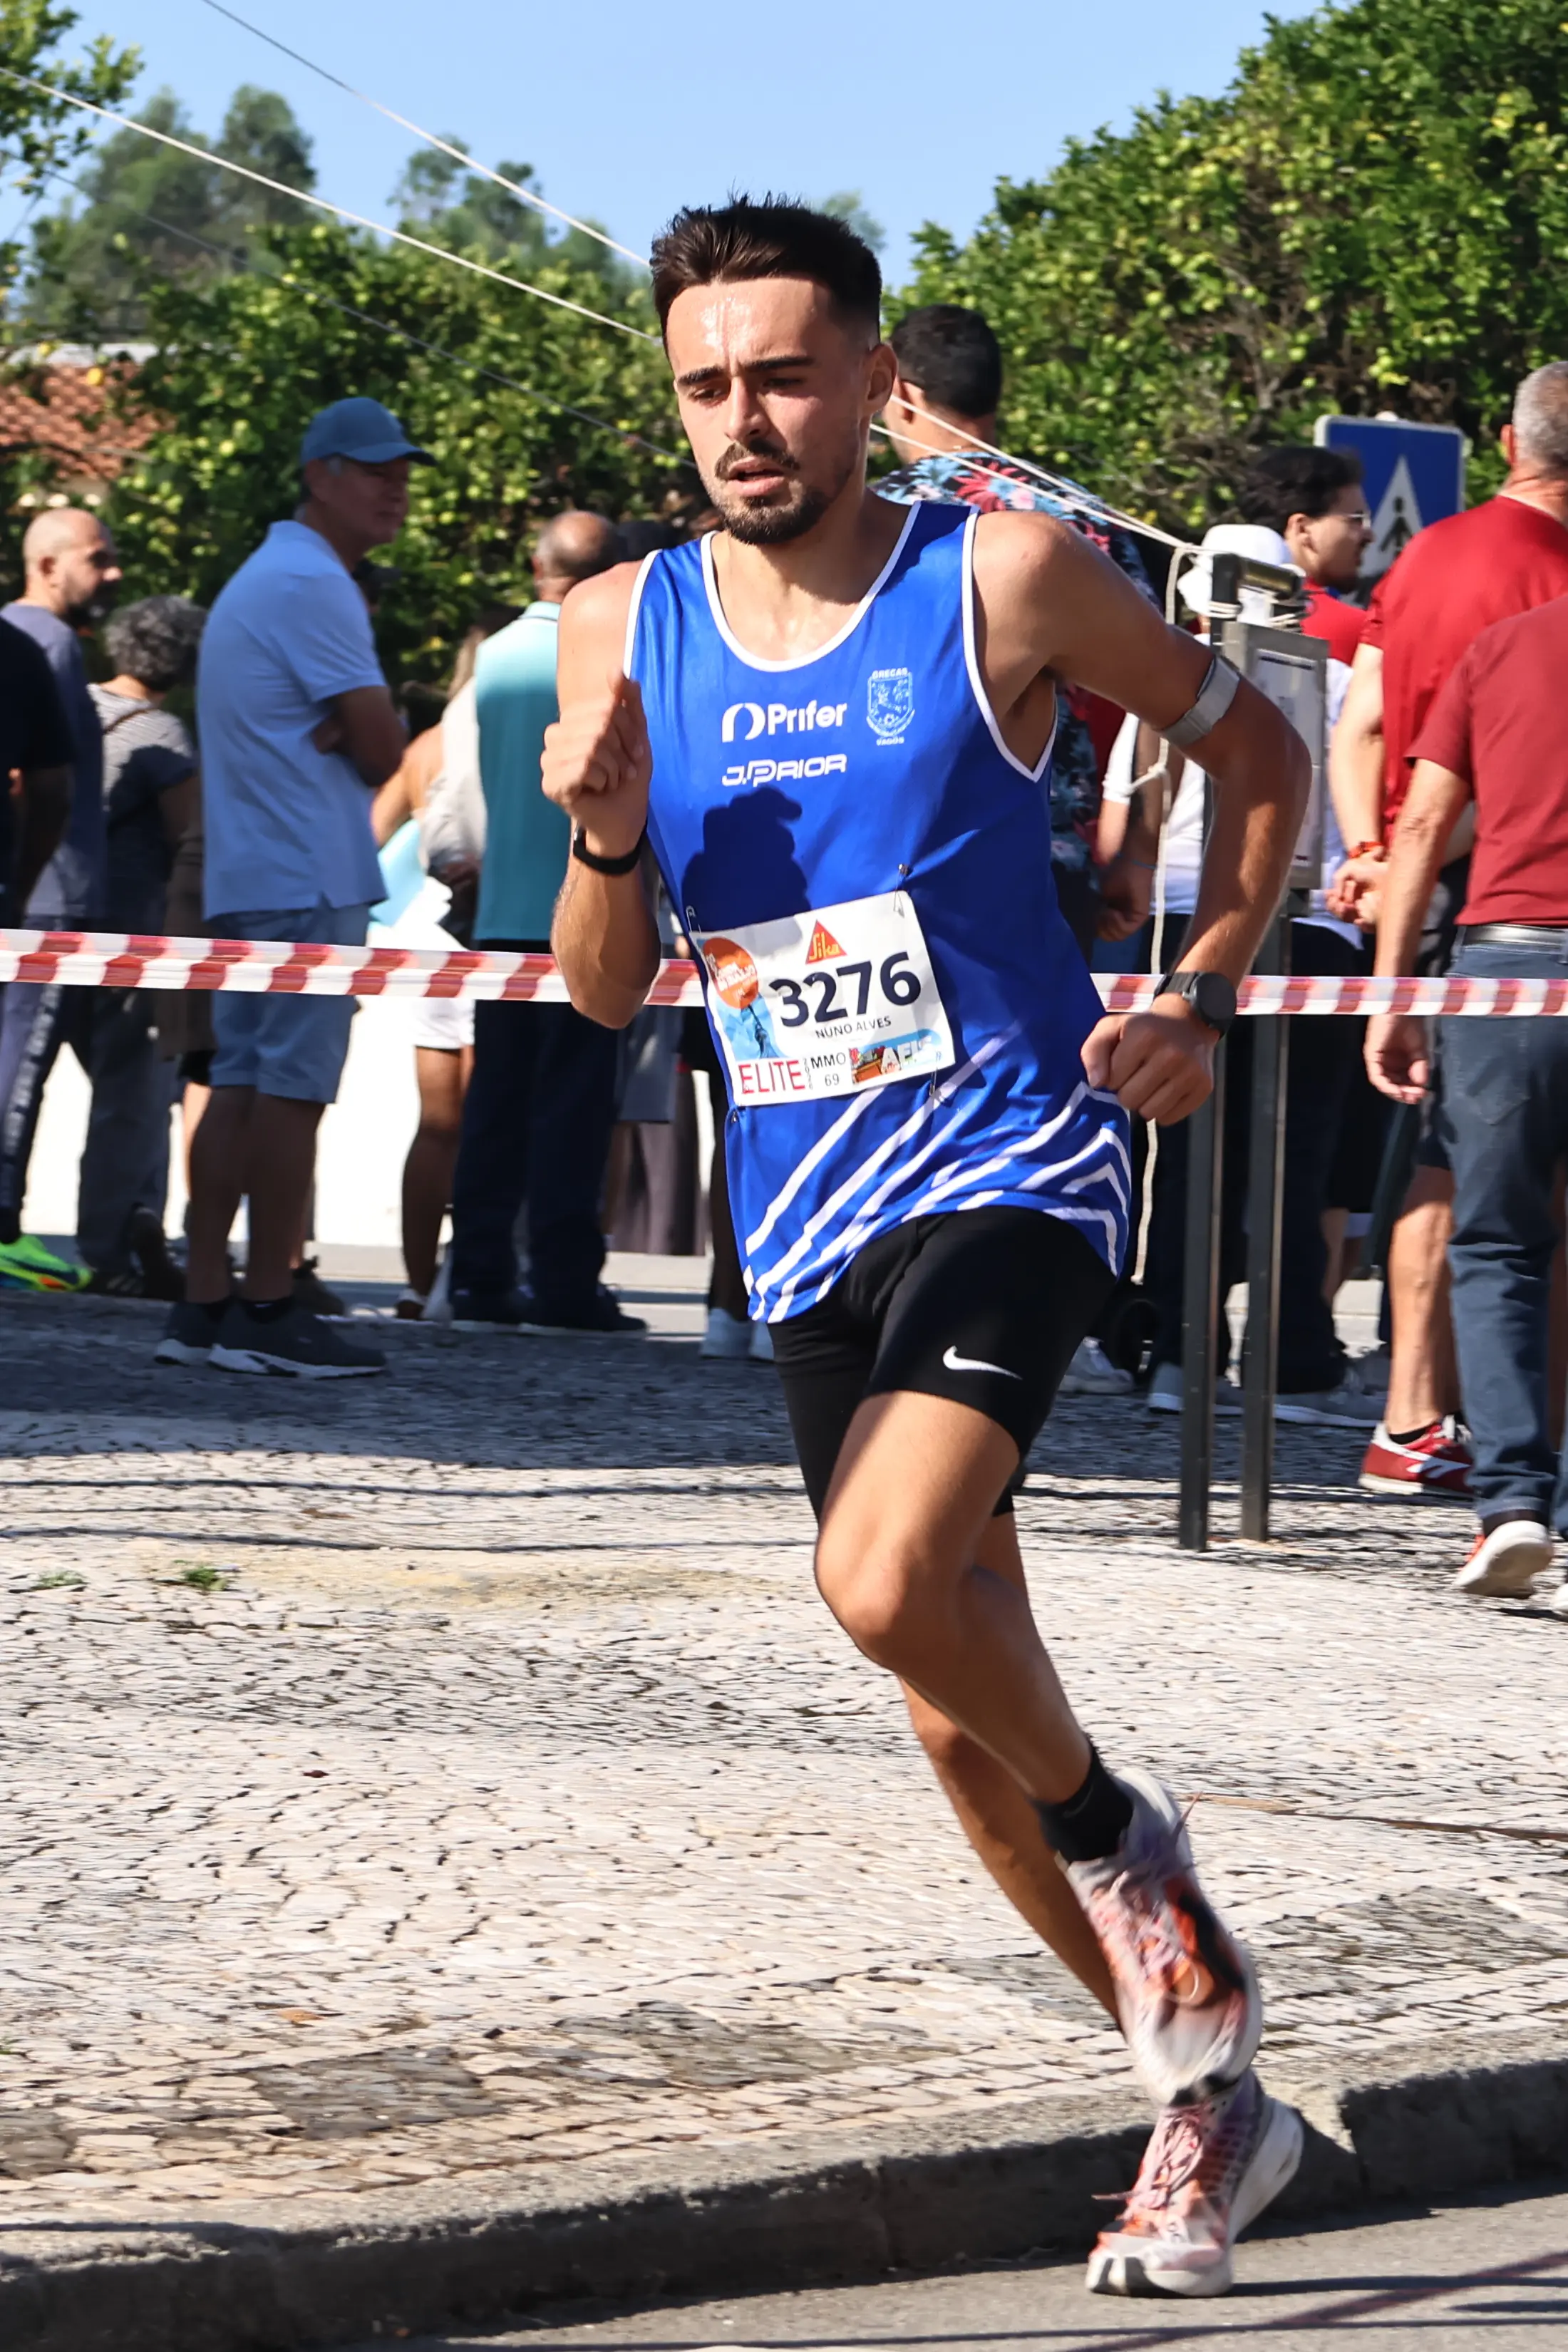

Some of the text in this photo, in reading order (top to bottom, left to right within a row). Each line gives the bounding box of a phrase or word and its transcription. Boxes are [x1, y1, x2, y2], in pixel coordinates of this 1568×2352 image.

[768, 700, 847, 735] Prifer
[809, 932, 840, 960] Sika
[769, 951, 921, 1027] 3276
[815, 1016, 892, 1039] NUNO ALVES
[811, 1051, 846, 1069] MMO
[738, 1061, 805, 1093] ELITE
[825, 1073, 840, 1087] 69
